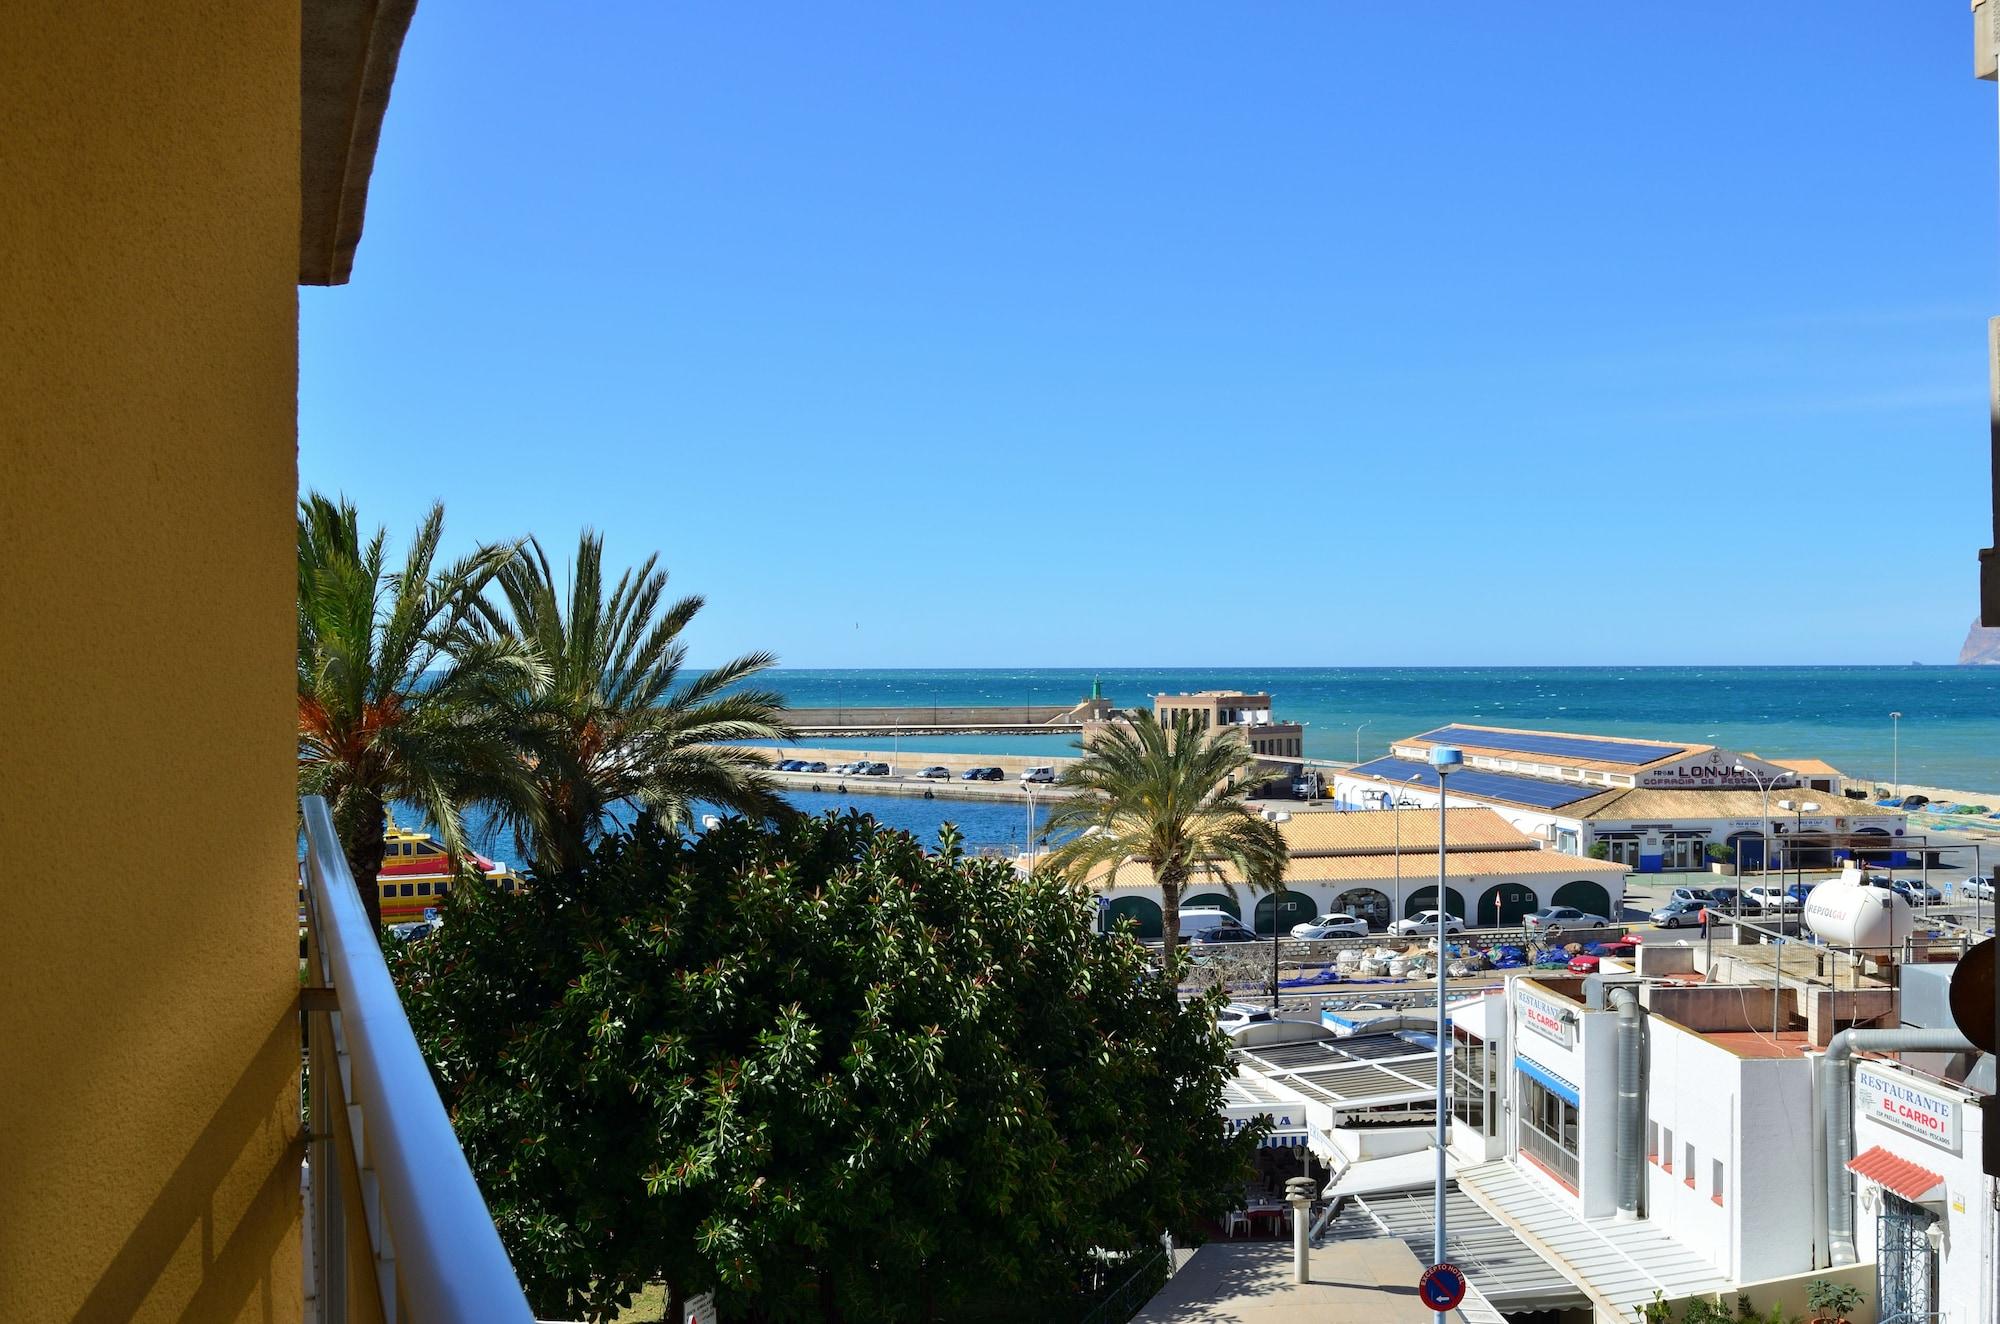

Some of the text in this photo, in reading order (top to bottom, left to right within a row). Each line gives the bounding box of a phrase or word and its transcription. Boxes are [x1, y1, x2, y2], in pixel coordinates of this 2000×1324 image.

[1679, 766, 1744, 778] LONJA
[1527, 1008, 1536, 1020] EL
[1536, 1013, 1559, 1031] CARRO
[1860, 1072, 1949, 1117] RESTAURANTE
[1883, 1098, 1896, 1113] EL
[1898, 1105, 1938, 1129] CARRO
[1421, 1264, 1464, 1286] EXCEPTO HOTEL
